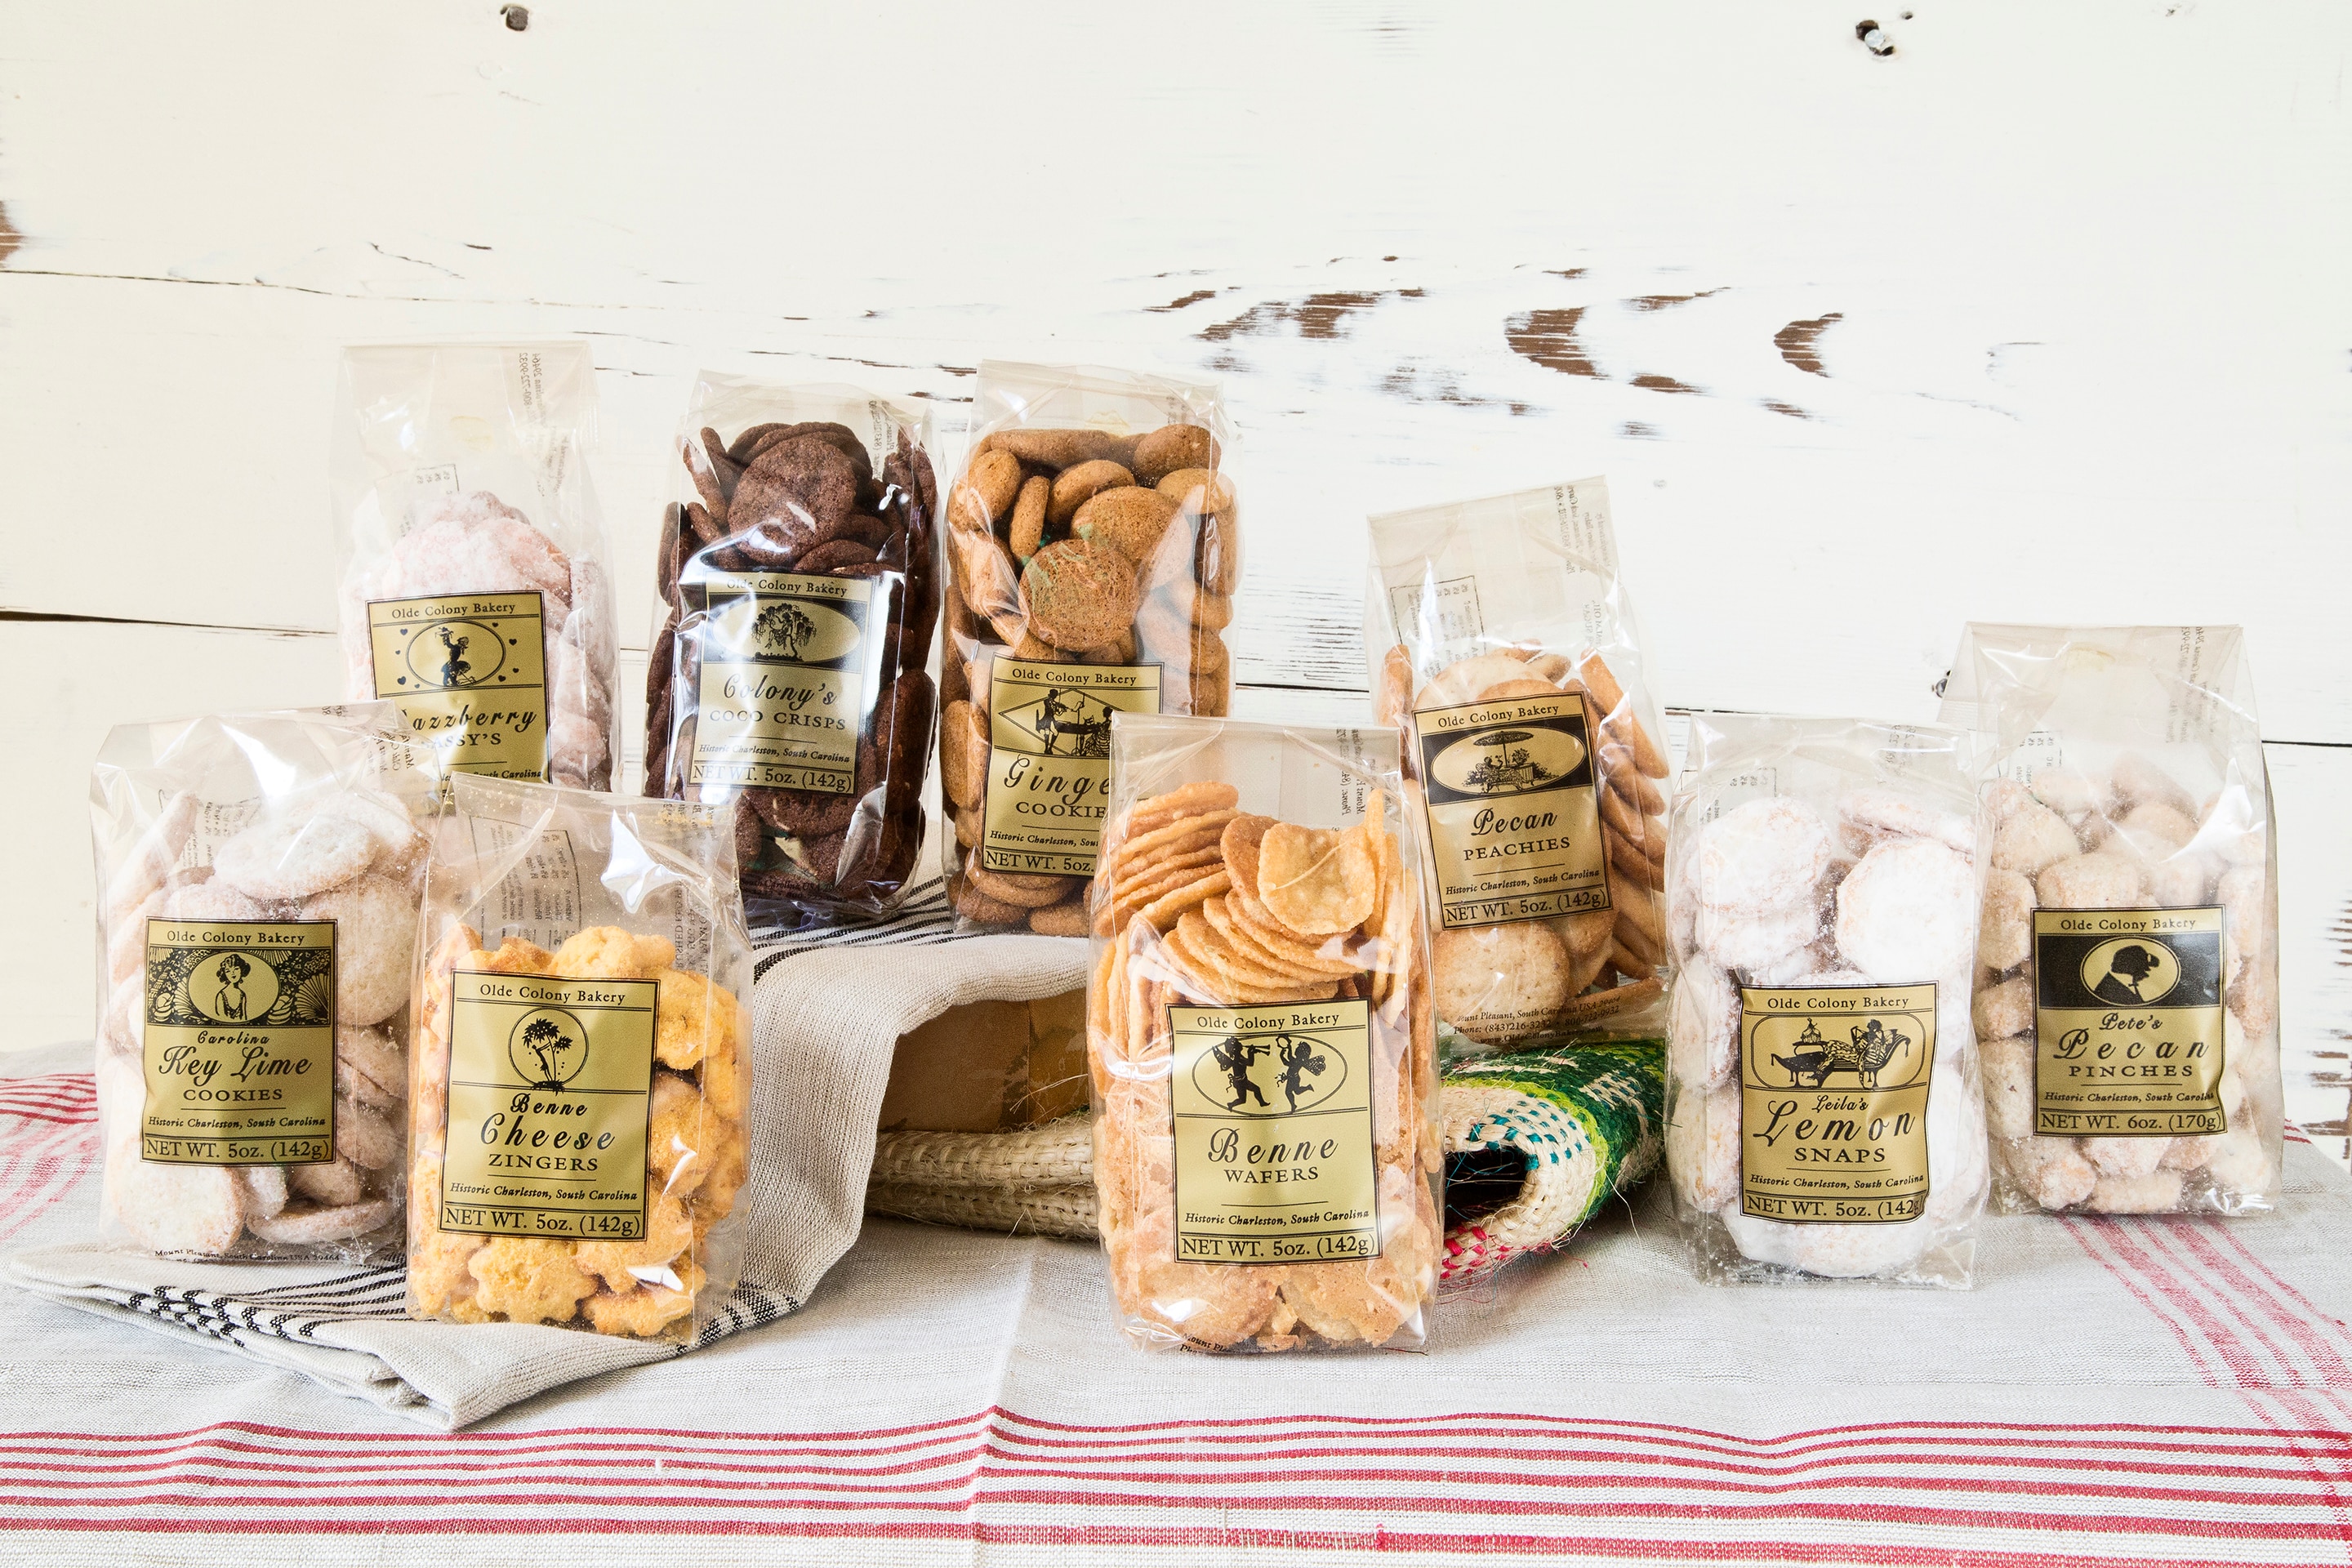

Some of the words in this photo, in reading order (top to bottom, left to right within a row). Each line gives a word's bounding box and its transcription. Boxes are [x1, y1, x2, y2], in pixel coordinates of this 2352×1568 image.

[727, 579, 752, 589] Olde
[759, 580, 801, 593] Colony
[807, 582, 848, 597] Bakery
[392, 608, 420, 619] Olde
[425, 605, 468, 616] Colony
[474, 603, 516, 614] Bakery
[1012, 668, 1040, 679] Olde
[1046, 671, 1089, 685] Colony
[1095, 674, 1137, 686] Bakery
[724, 673, 837, 710] Colony's
[403, 705, 537, 733] azzberry
[710, 710, 764, 722] COCO
[773, 712, 846, 729] CRISPS
[1438, 716, 1465, 727] Olde
[1470, 711, 1512, 724] Colony
[1518, 705, 1559, 717] Bakery
[699, 745, 728, 753] Historic
[732, 746, 780, 757] Charleston,
[783, 748, 808, 758] South
[810, 751, 850, 763] Carolina
[501, 770, 542, 779] Carolina
[693, 766, 726, 780] NET
[729, 767, 757, 781] WT.
[765, 768, 795, 784] 5oz.
[802, 770, 852, 792] (142g)
[1004, 754, 1109, 806] Ginge
[1016, 801, 1106, 818] COOKIE
[1471, 807, 1557, 836] Pecan
[990, 831, 1023, 842] Historic
[1027, 835, 1077, 848] Charleston,
[1080, 838, 1098, 846] Sou
[1463, 836, 1570, 861] PEACHIES
[986, 852, 1022, 867] NET
[1026, 855, 1055, 870] WT.
[1063, 858, 1094, 872] 5oz.
[1446, 884, 1478, 894] Historic
[1481, 879, 1530, 890] Charleston,
[1533, 874, 1557, 884] South
[1561, 870, 1600, 880] Carolina
[1446, 906, 1478, 922] NET
[1481, 902, 1512, 918] WT.
[1521, 899, 1552, 913] 5oz.
[1557, 889, 1606, 912] (142g)
[2060, 920, 2092, 930] Olde
[2099, 920, 2147, 931] Colony
[2153, 919, 2196, 930] Bakery
[167, 930, 196, 942] Olde
[203, 932, 252, 945] Colony
[258, 933, 305, 946] Bakery
[479, 984, 513, 996] Olde
[519, 987, 571, 1003] Colony
[577, 990, 626, 1005] Bakery
[1767, 998, 1801, 1009] Olde
[1806, 998, 1856, 1010] Colony
[1863, 996, 1909, 1009] Bakery
[1454, 1026, 1481, 1034] Phone:
[1486, 1021, 1551, 1033] (843)216-3232
[1565, 1004, 1619, 1026] 800-722-9932
[1481, 1012, 1515, 1020] Pleasant,
[1517, 1009, 1539, 1018] South
[1541, 1007, 1577, 1015] Carolina
[1579, 1002, 1597, 1012] USA
[1197, 1017, 1228, 1028] Olde
[1235, 1018, 1285, 1029] Colony
[1292, 1013, 1339, 1026] Bakery
[2099, 1013, 2163, 1031] Pete's
[198, 1031, 270, 1045] Carolina
[2053, 1028, 2209, 1060] Pecan
[158, 1045, 222, 1086] Key
[230, 1046, 312, 1083] Lime
[2069, 1066, 2193, 1077] PINCHES
[183, 1089, 283, 1101] COOKIES
[1812, 1095, 1869, 1112] Leila's
[2044, 1092, 2083, 1102] Historic
[2087, 1094, 2141, 1102] Charleston,
[2145, 1094, 2173, 1102] South
[510, 1093, 587, 1116] Benne
[149, 1116, 184, 1127] Historic
[188, 1119, 243, 1129] Charleston,
[247, 1118, 275, 1128] South
[279, 1117, 326, 1127] Carolina
[1753, 1100, 1916, 1147] Lemon
[2041, 1114, 2081, 1129] NET
[2087, 1116, 2119, 1129] WT.
[2127, 1116, 2162, 1129] 6oz.
[2168, 1112, 2221, 1131] (170g)
[480, 1113, 615, 1150] Cheese
[147, 1139, 182, 1156] NET
[188, 1143, 220, 1158] WT.
[229, 1142, 265, 1158] 5oz.
[270, 1140, 328, 1160] (142g)
[1208, 1128, 1339, 1164] Benne
[488, 1153, 598, 1171] ZINGERS
[1794, 1148, 1886, 1163] SNAPS
[1224, 1166, 1319, 1183] WAFERS
[1749, 1174, 1789, 1186] Historic
[1793, 1178, 1850, 1191] Charleston,
[1854, 1178, 1882, 1189] South
[1886, 1174, 1924, 1187] Carolina
[450, 1183, 491, 1195] Historic
[494, 1186, 552, 1199] Charleston,
[556, 1189, 585, 1199] South
[589, 1190, 638, 1200] Carolina
[1747, 1196, 1787, 1214] NET
[1791, 1200, 1827, 1216] WT.
[1836, 1200, 1871, 1217] 5oz.
[446, 1208, 486, 1225] NET
[491, 1211, 527, 1228] WT.
[537, 1213, 572, 1231] 5oz.
[580, 1215, 640, 1236] (142g)
[1185, 1213, 1225, 1224] Historic
[1228, 1215, 1286, 1227] Charleston,
[1291, 1213, 1320, 1224] South
[1324, 1209, 1369, 1222] Carolina
[1182, 1239, 1223, 1255] NET
[1227, 1241, 1263, 1257] WT.
[1273, 1241, 1310, 1256] 5oz.
[1317, 1234, 1374, 1256] (142g)
